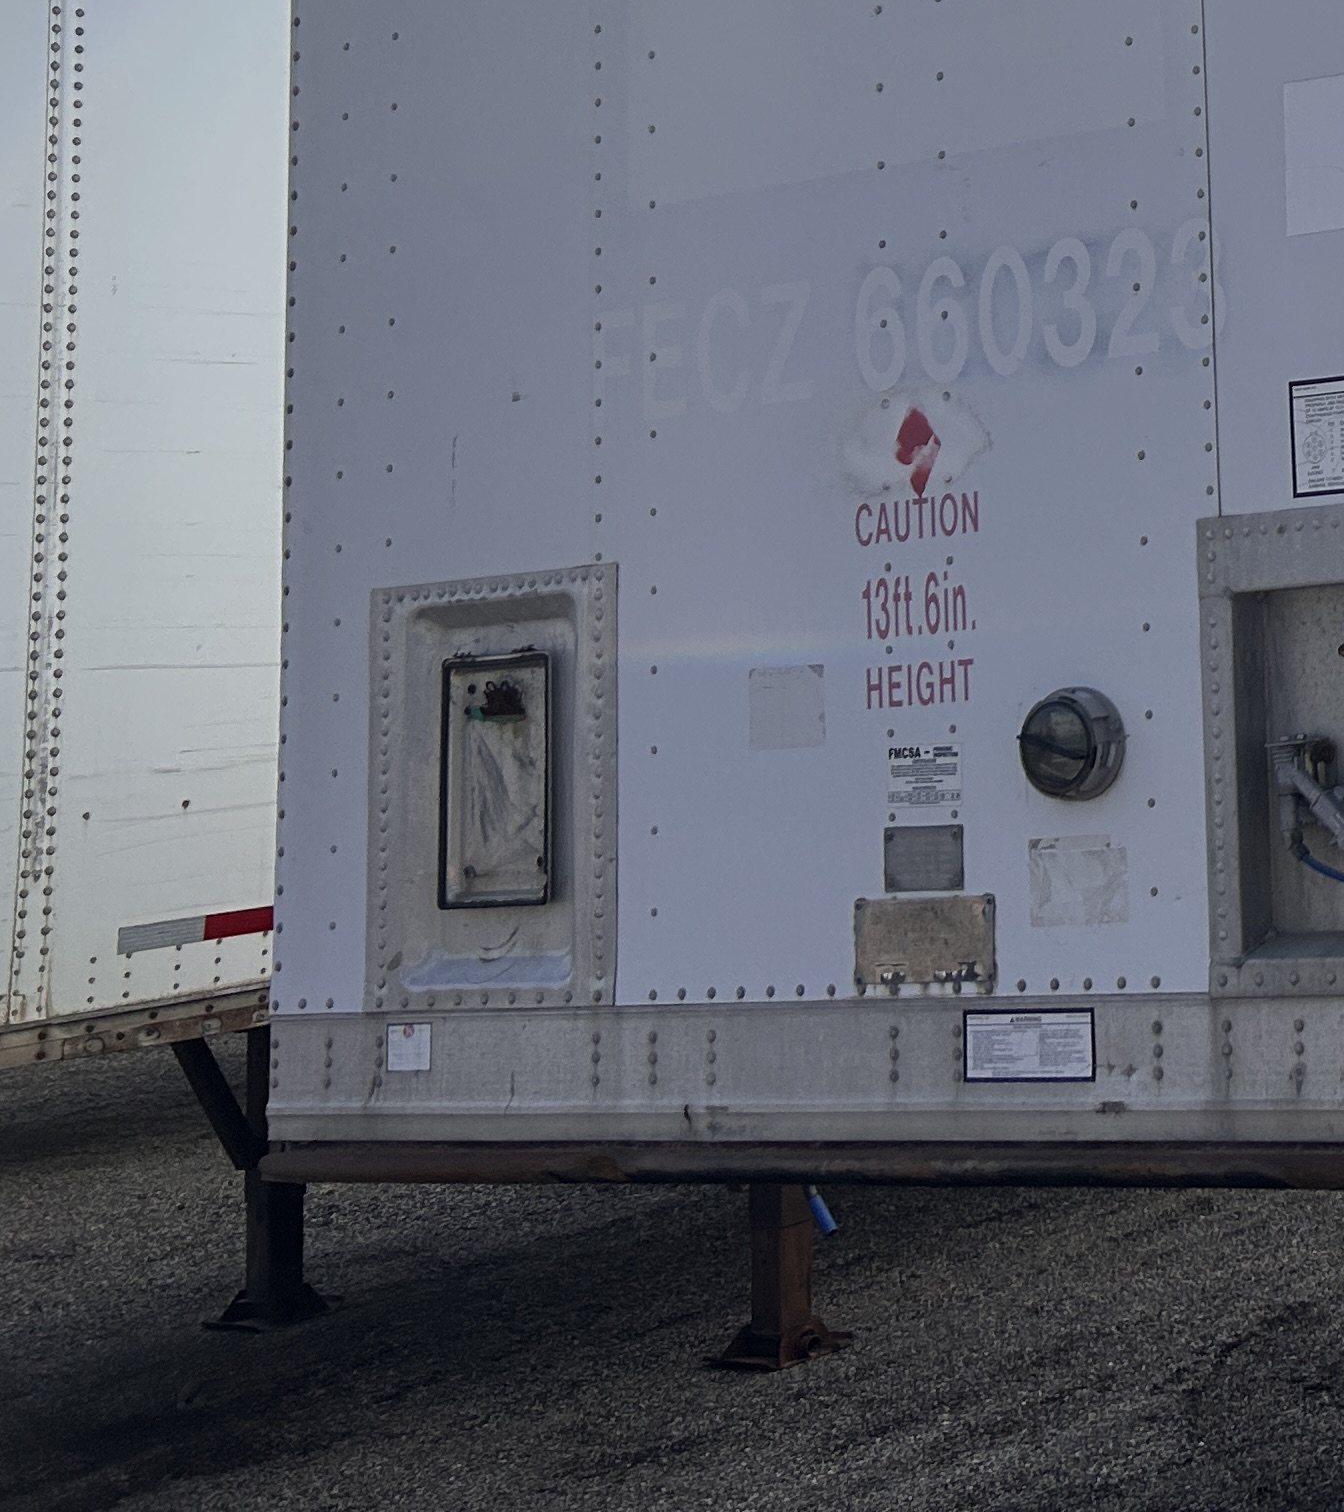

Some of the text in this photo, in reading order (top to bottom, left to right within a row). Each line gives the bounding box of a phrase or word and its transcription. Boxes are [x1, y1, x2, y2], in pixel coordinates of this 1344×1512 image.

[592, 217, 1228, 428] FECZ 660323
[854, 490, 981, 548] CAUTION
[865, 658, 976, 711] HEIGHT
[888, 746, 921, 760] FMCSA
